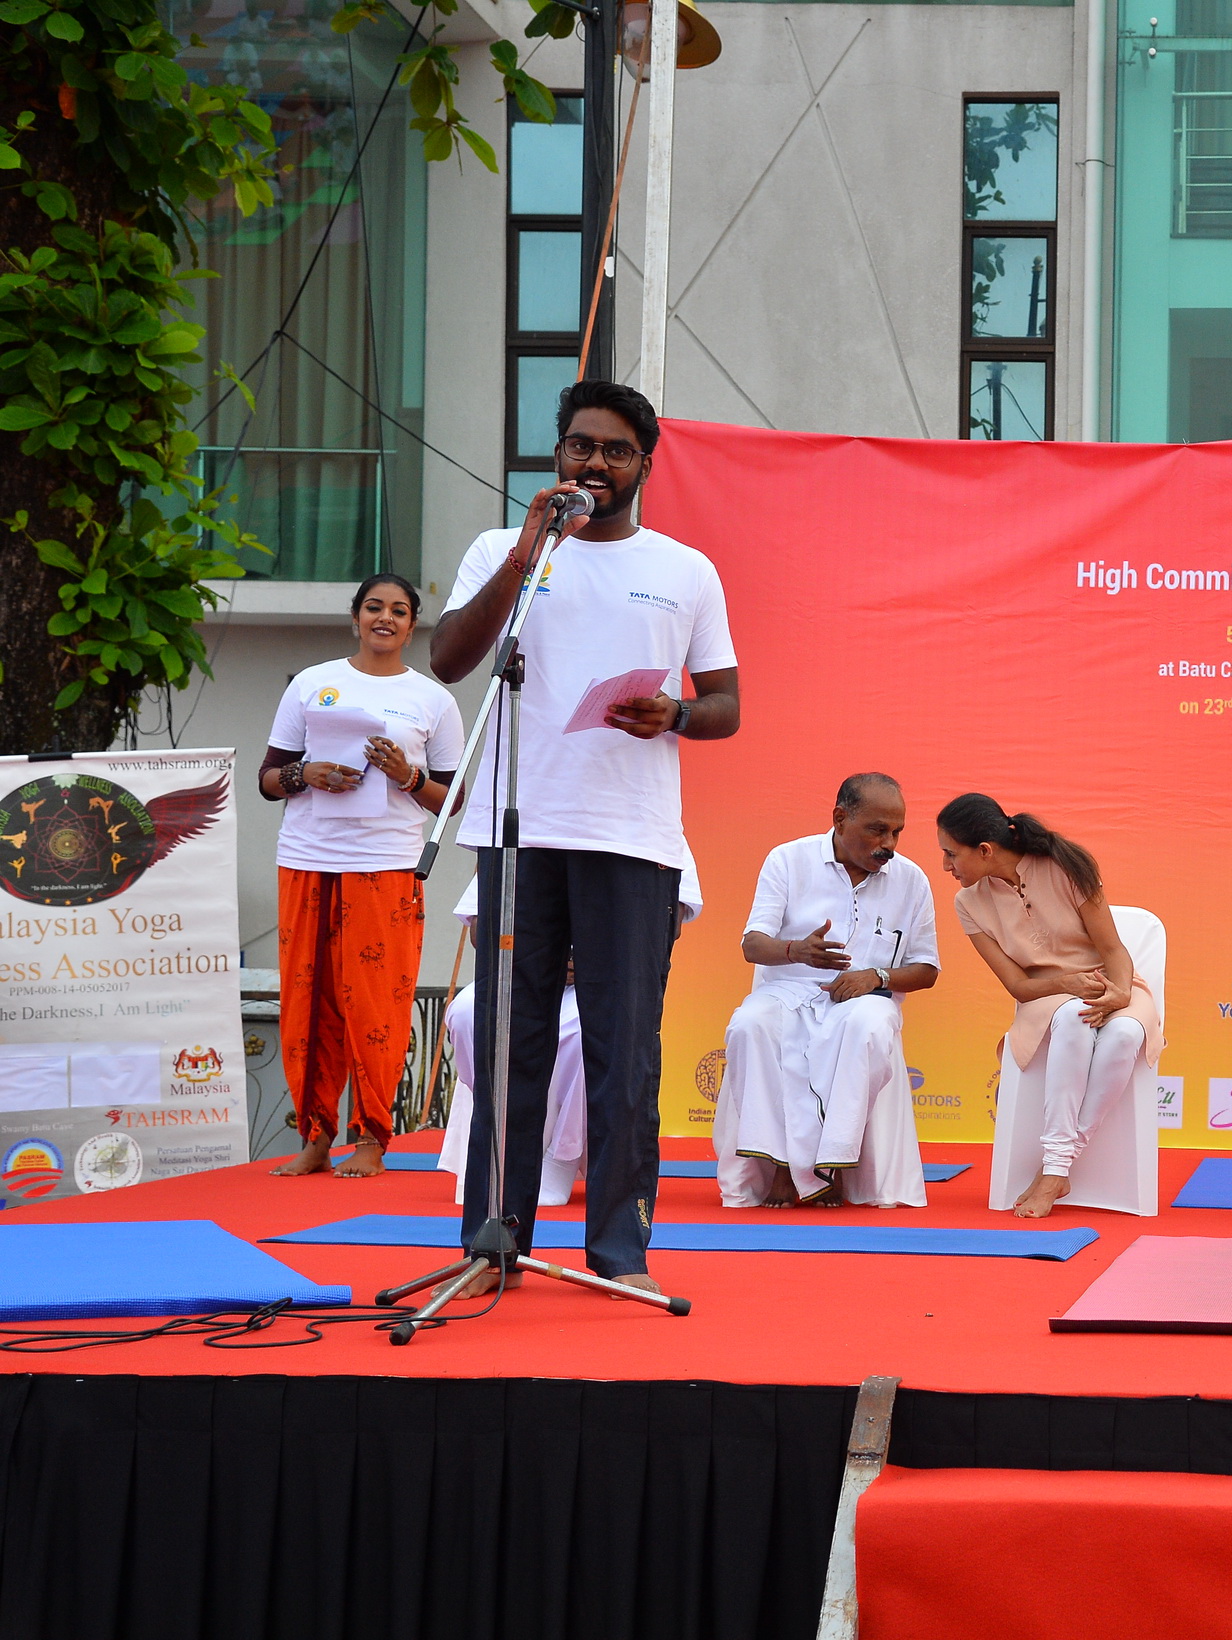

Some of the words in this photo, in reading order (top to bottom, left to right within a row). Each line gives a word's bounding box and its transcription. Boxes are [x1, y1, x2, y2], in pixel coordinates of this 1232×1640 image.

[1076, 560, 1137, 595] High
[629, 591, 651, 600] TATA
[652, 595, 679, 609] MOTORS
[1157, 661, 1174, 677] at
[1178, 660, 1216, 678] Batu
[1179, 701, 1199, 714] on
[108, 907, 184, 940] Yoga
[51, 947, 230, 980] Association
[113, 1002, 141, 1016] Am
[170, 1082, 231, 1097] Malaysia
[123, 1107, 230, 1128] TAHSRAM
